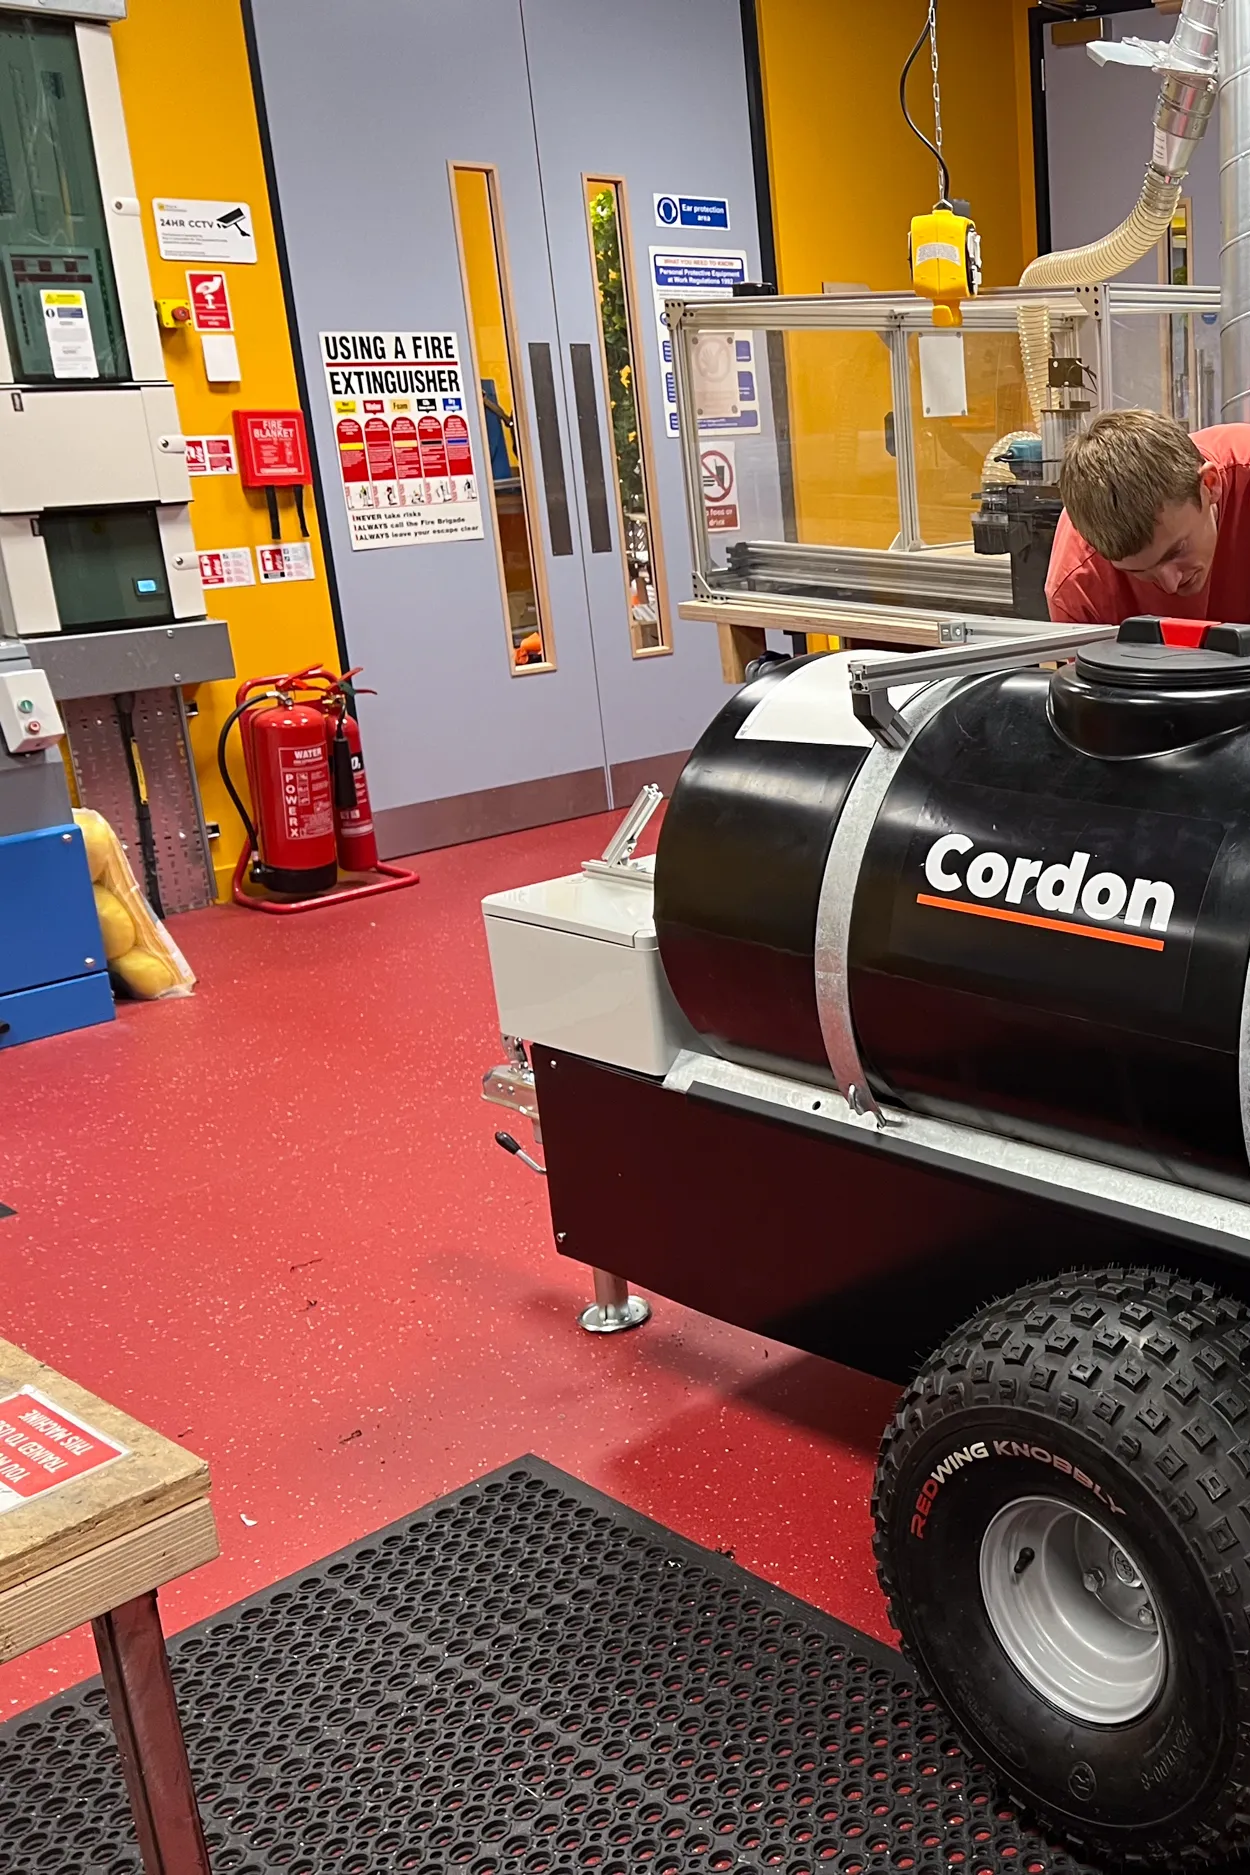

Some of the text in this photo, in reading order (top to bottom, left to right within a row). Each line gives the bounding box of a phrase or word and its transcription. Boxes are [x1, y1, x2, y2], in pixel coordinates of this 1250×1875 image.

[682, 204, 724, 215] Ear protection
[160, 219, 214, 229] 24HR CCTV
[659, 268, 740, 279] Personal Protective Equipment
[688, 278, 720, 286] Regulations
[325, 336, 455, 360] USING A FIRE
[329, 370, 460, 395] EXTINGUISHER
[262, 420, 283, 430] FIRE
[253, 429, 294, 439] BLANKET
[437, 517, 465, 526] Brigade
[414, 529, 430, 537] your
[432, 527, 458, 535] escape
[294, 747, 322, 759] WATER
[924, 833, 1175, 932] Cordon
[18, 1409, 94, 1456] THIS MACHINE
[4, 1432, 30, 1447] TO
[17, 1441, 69, 1474] TRAINED
[0, 1462, 31, 1484] YOU
[910, 1440, 1127, 1540] REDWING KNOBBLY
